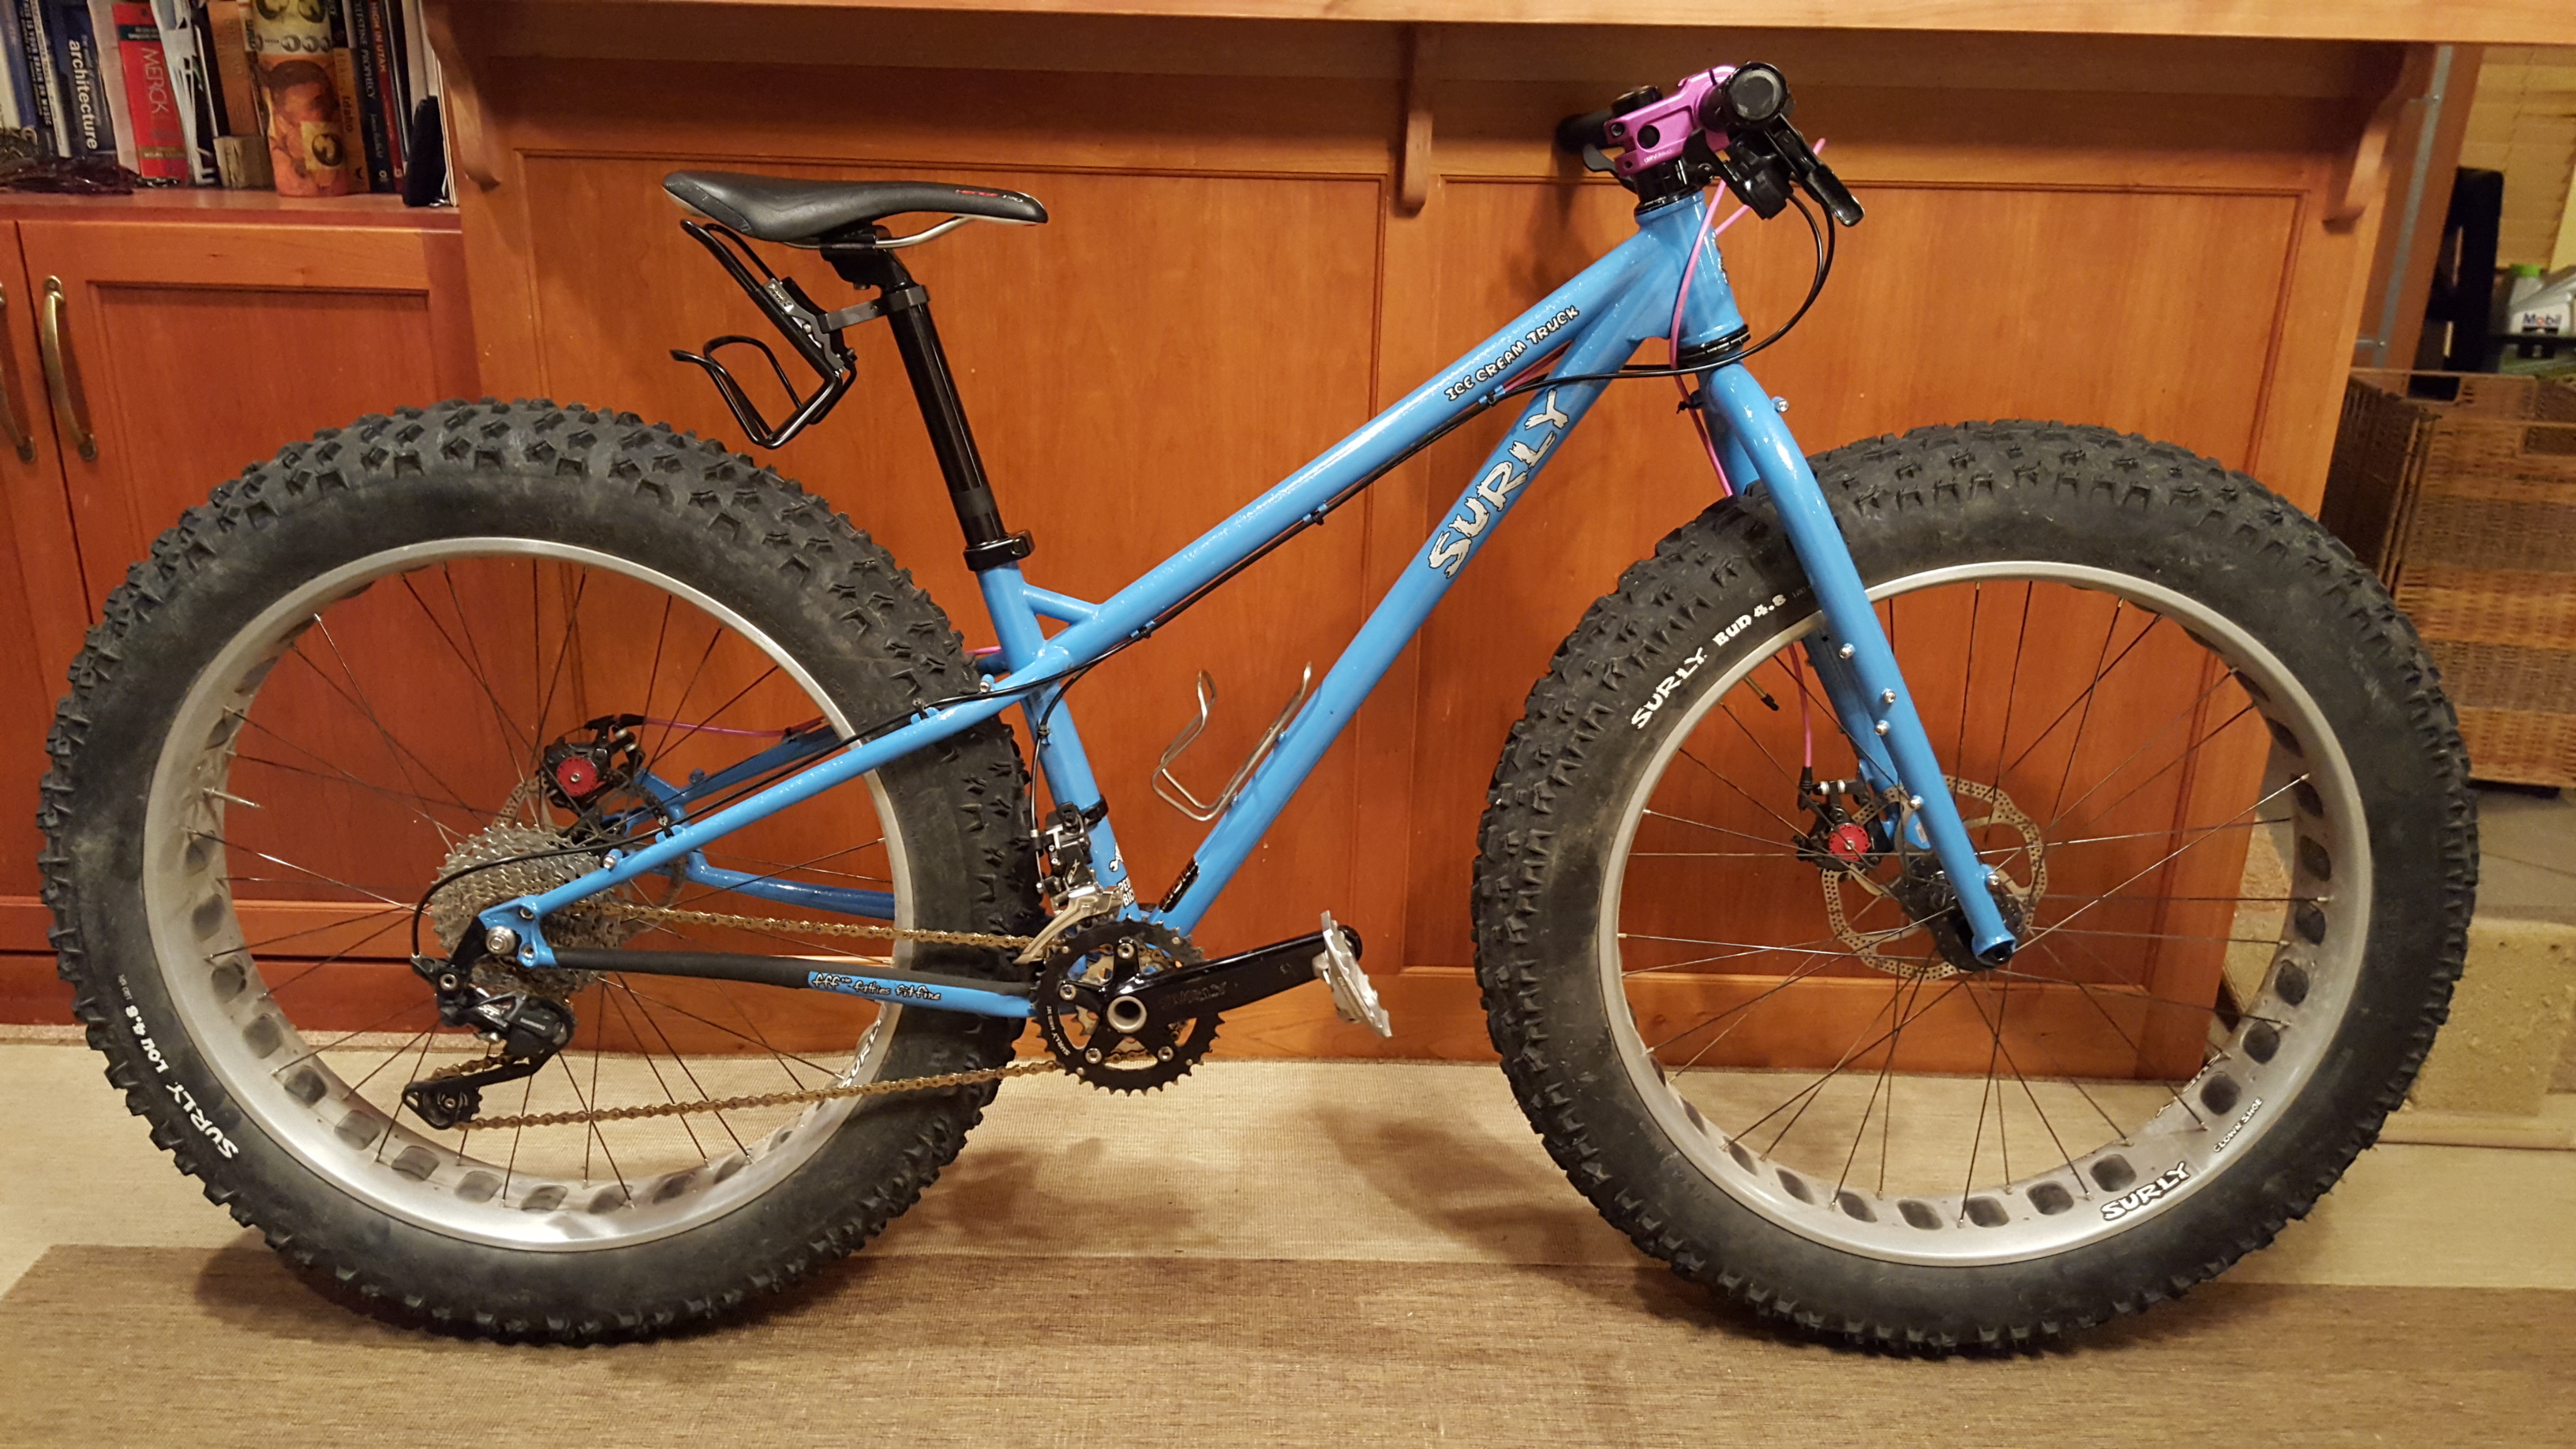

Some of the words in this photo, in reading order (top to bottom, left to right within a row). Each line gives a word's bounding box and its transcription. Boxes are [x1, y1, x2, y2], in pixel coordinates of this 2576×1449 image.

[69, 39, 98, 149] architecture
[141, 47, 169, 114] MERCK
[1445, 375, 1475, 401] ICE
[1475, 340, 1527, 383] CREAM
[1526, 305, 1579, 344] TRUCK
[1428, 388, 1569, 578] SURLY
[1631, 646, 1704, 730] SURLY
[1712, 614, 1752, 647] BUD
[853, 980, 891, 995] fatties
[1051, 1032, 1071, 1056] SURLY
[165, 1081, 239, 1159] SURLY
[2212, 1121, 2242, 1153] CLOWN
[2241, 1097, 2263, 1124] SHOE
[2100, 1161, 2191, 1222] SURLY
